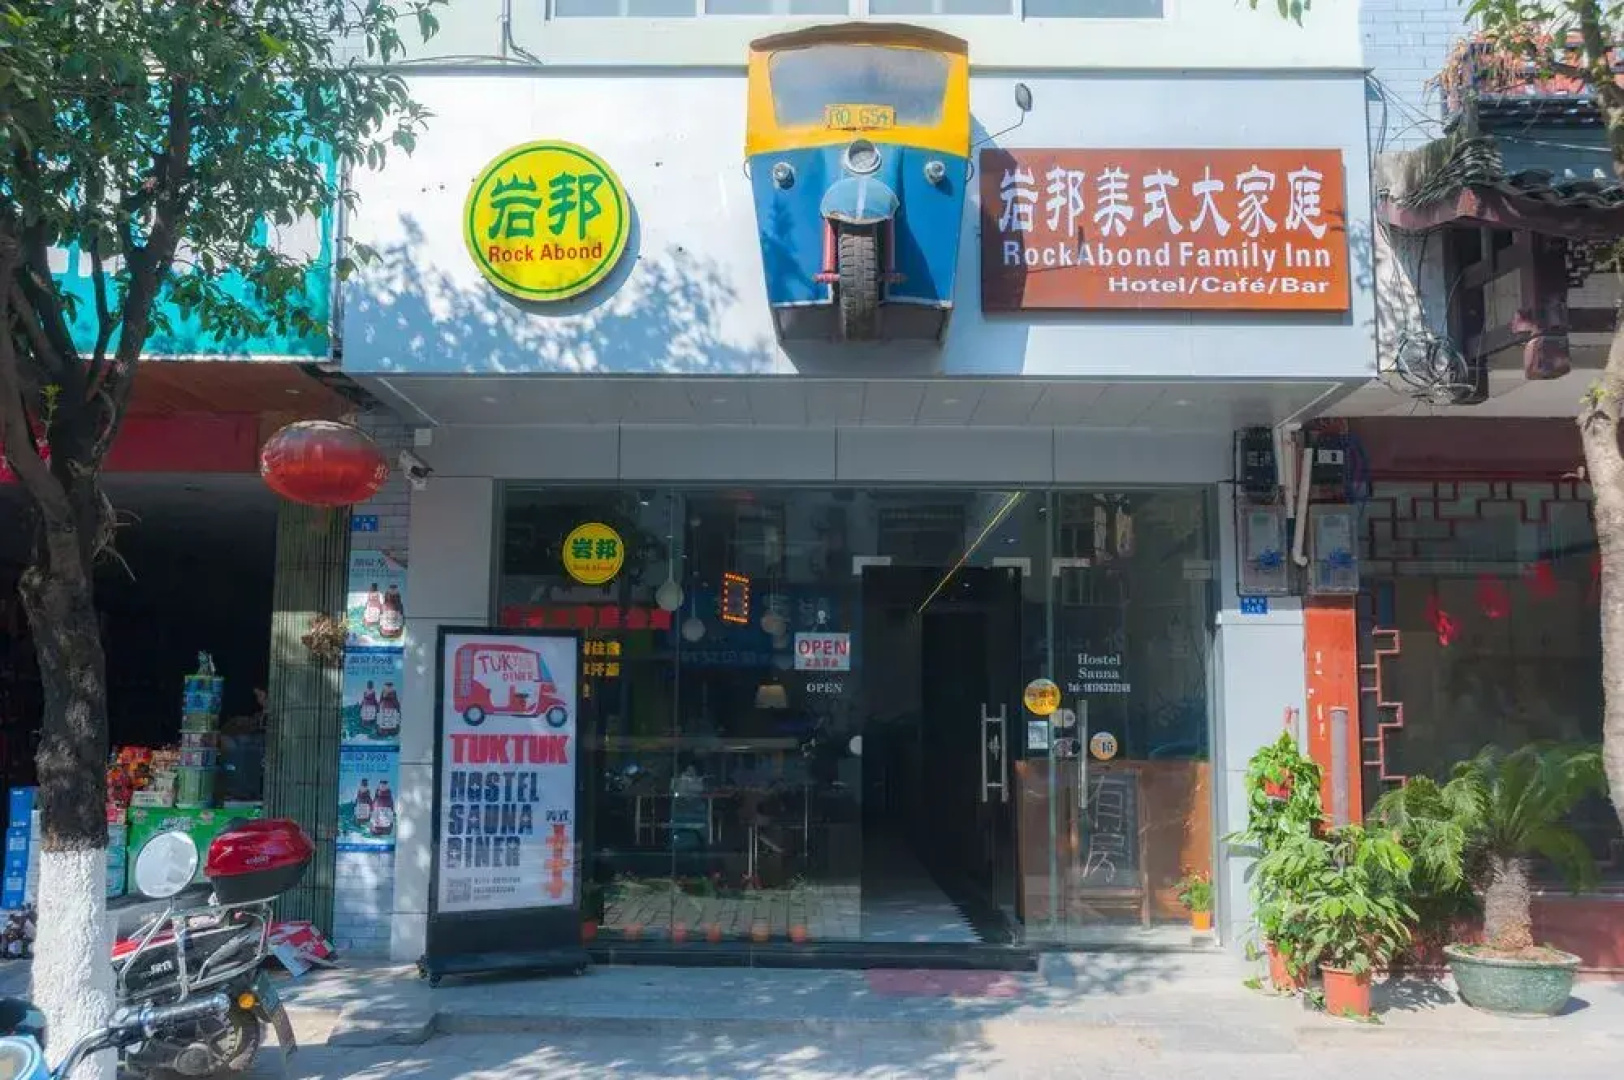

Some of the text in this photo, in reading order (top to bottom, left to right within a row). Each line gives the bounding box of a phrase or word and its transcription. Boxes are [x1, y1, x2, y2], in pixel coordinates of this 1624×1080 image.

[487, 171, 604, 240] 岩邦
[999, 163, 1328, 239] 岩邦美式大家庭
[488, 242, 603, 263] Rock Abond
[1179, 240, 1277, 272] Family
[1285, 241, 1331, 267] Inn
[1108, 276, 1331, 295] Hotel/Café/Bar
[571, 537, 618, 560] 岩邦
[798, 639, 847, 656] OPEN
[1077, 653, 1122, 665] Hostel
[1078, 667, 1120, 679] Sauna
[806, 683, 843, 693] OPEN
[449, 733, 571, 765] TUKTUK
[450, 771, 540, 802] HOSTEL
[448, 803, 534, 835] SAUNA
[446, 836, 521, 868] DINER
